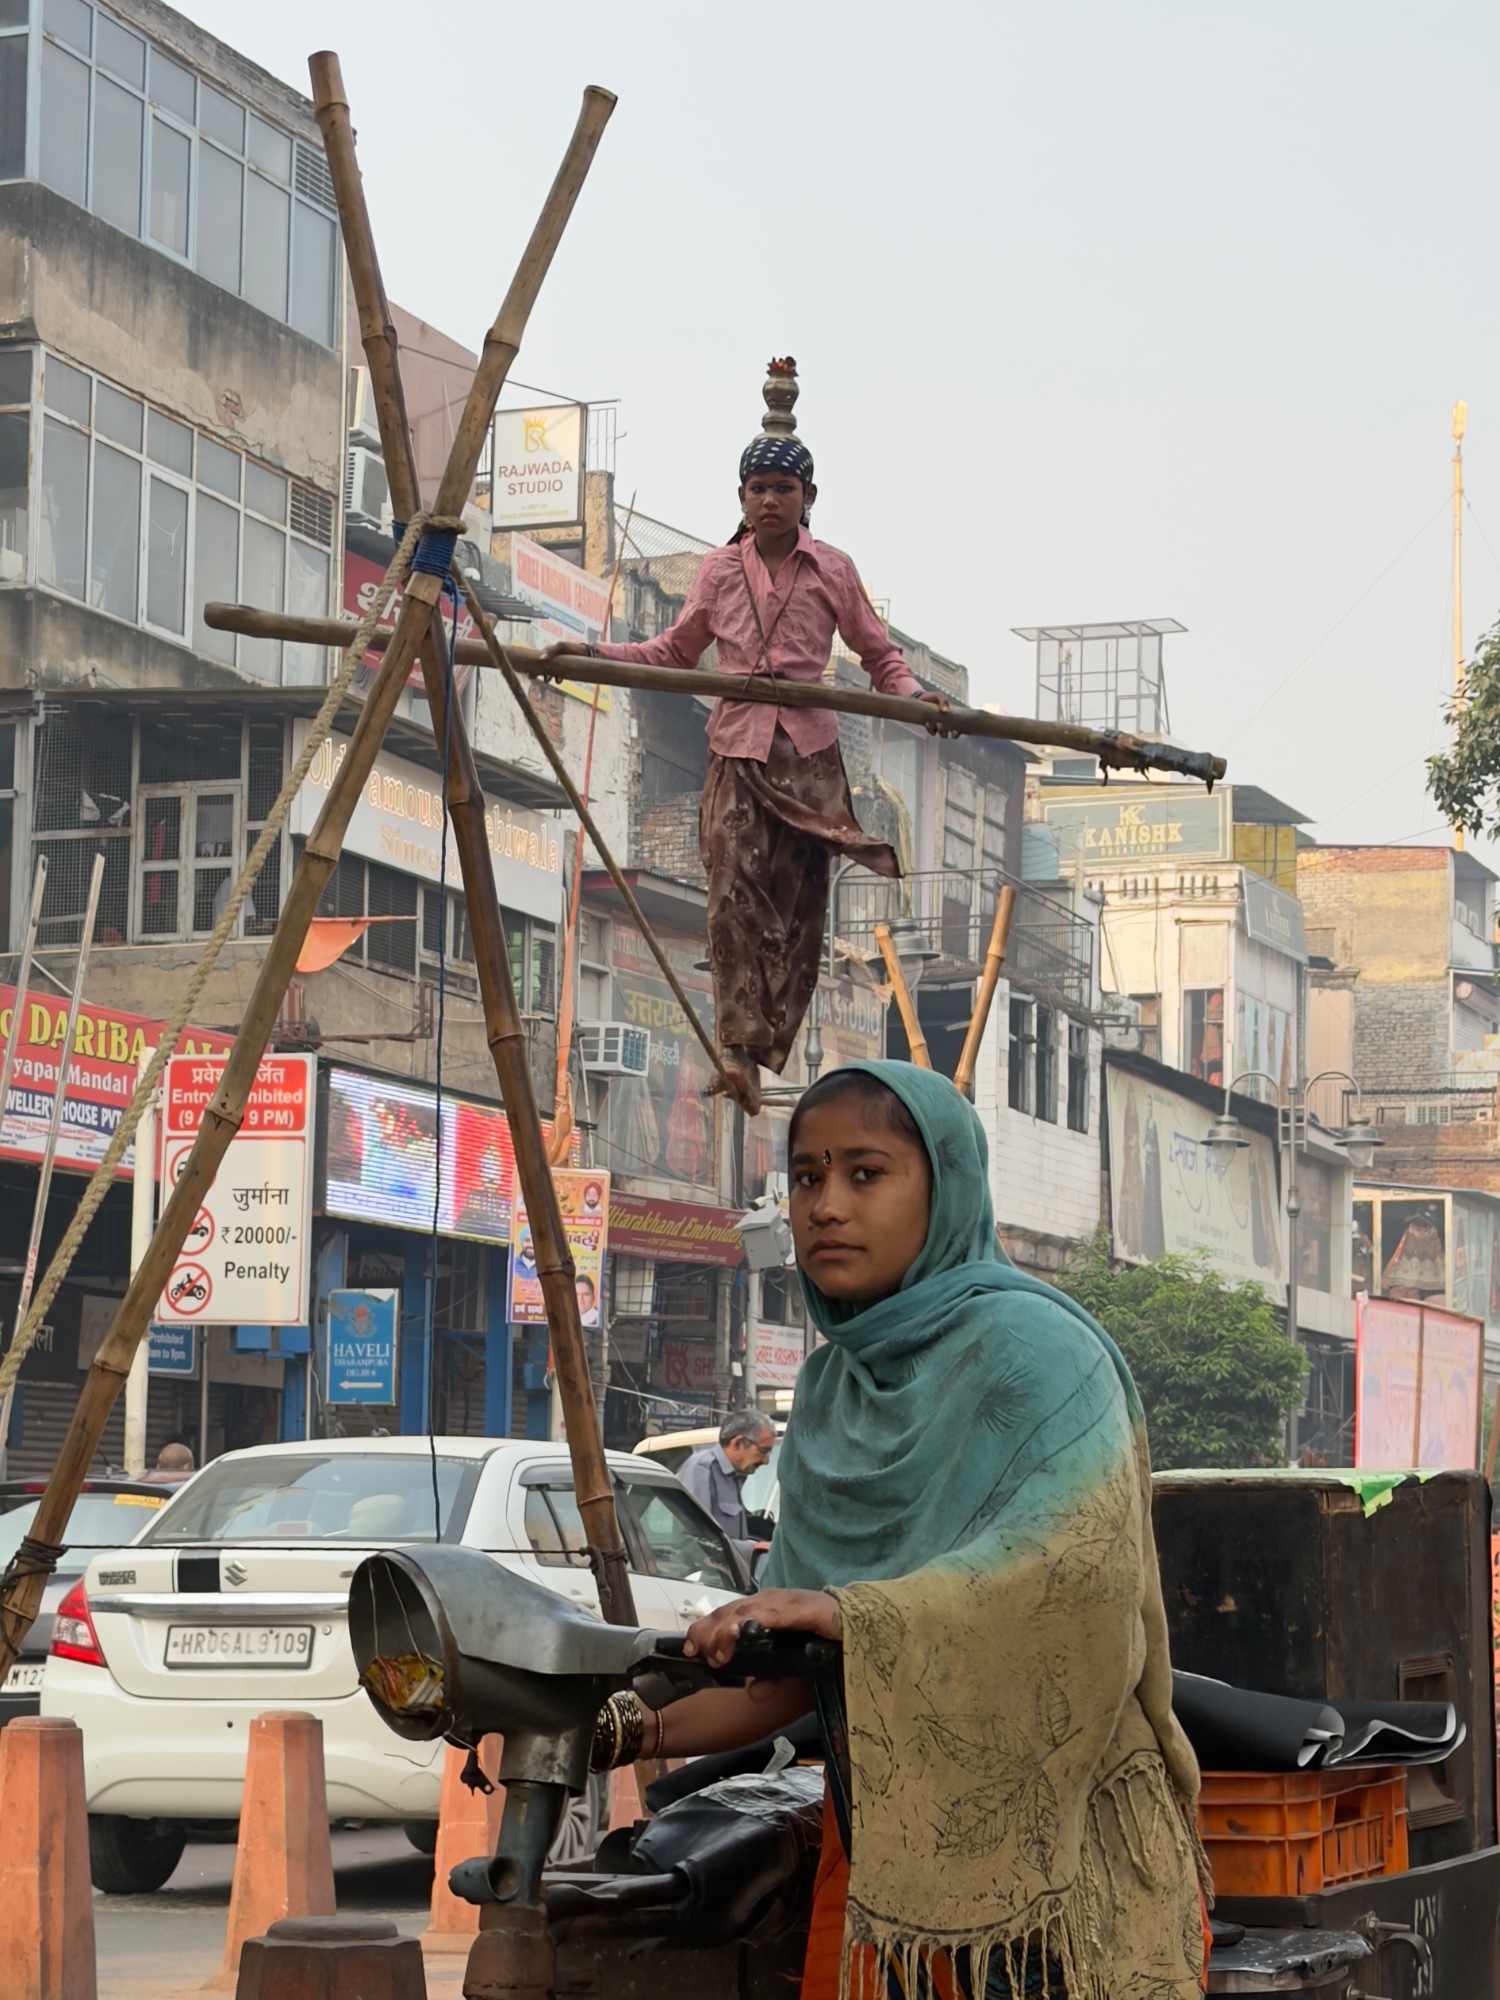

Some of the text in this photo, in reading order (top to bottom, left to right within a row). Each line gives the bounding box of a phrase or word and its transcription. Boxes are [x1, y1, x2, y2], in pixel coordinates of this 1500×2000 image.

[498, 460, 573, 479] RAJWADA
[507, 479, 563, 496] STUDIO
[368, 770, 443, 832] amous
[484, 804, 559, 875] ebiwala
[1085, 822, 1184, 848] KANISHK
[380, 823, 439, 871] Since
[833, 989, 880, 1037] STUDIO
[28, 1003, 146, 1065] DARIBA
[12, 1057, 60, 1082] yapar
[66, 1063, 128, 1095] Mandal
[172, 1088, 213, 1107] Entry
[247, 1088, 303, 1104] hibited
[61, 1100, 99, 1126] HOUSE
[263, 1110, 294, 1128] PM)
[232, 1181, 289, 1211] जुर्माना
[234, 1226, 297, 1244] 20000/-
[224, 1261, 290, 1284] Penalty
[334, 1343, 389, 1357] HAVELI
